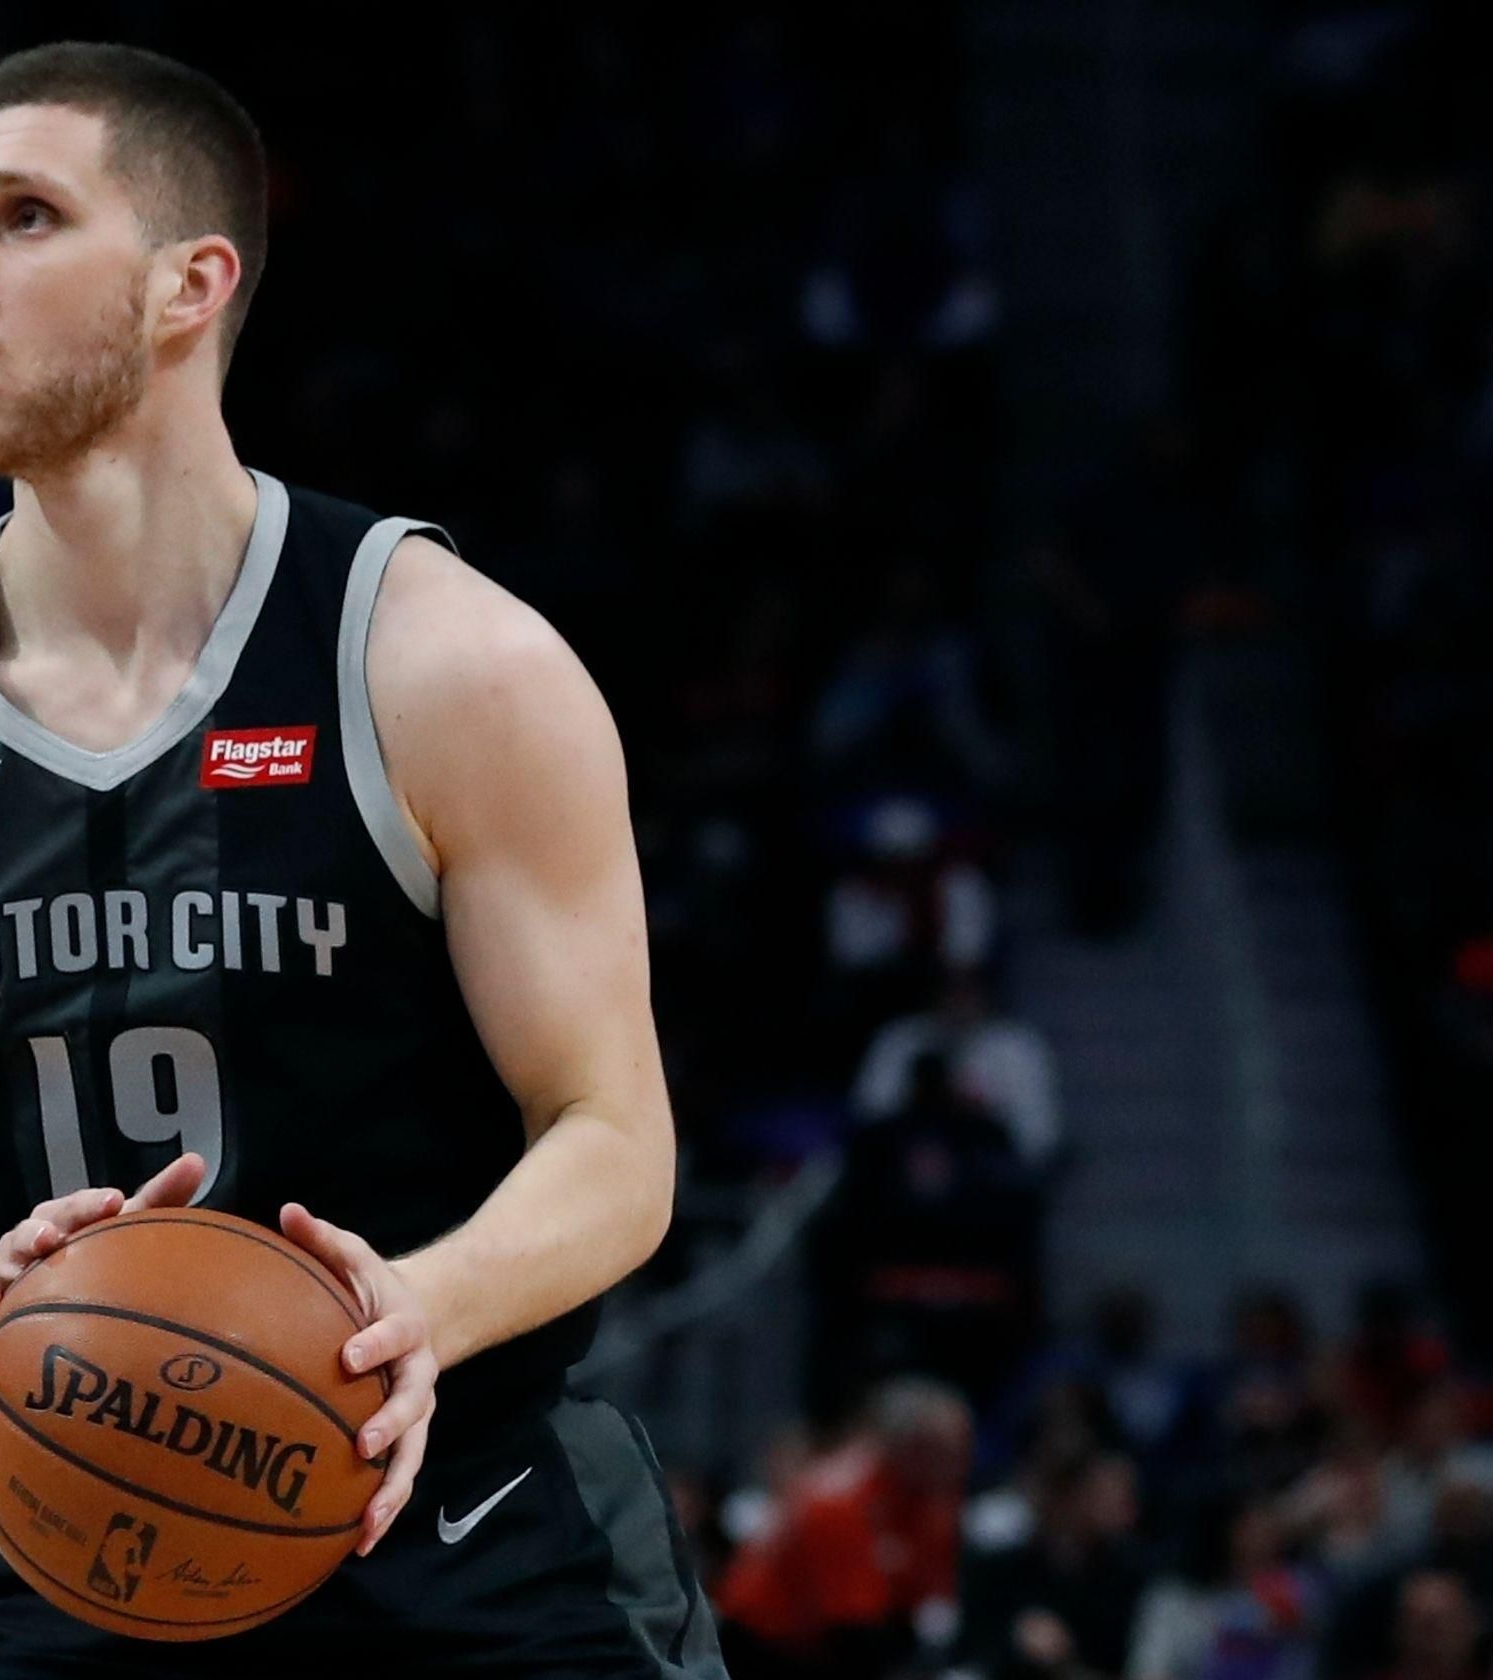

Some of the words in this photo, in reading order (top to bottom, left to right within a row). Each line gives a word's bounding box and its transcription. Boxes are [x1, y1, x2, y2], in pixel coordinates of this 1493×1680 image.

[210, 736, 307, 764] Flagstar
[269, 761, 302, 776] Bank
[172, 890, 346, 977] CITY
[28, 1026, 223, 1206] 19
[25, 1344, 317, 1513] SPALDING
